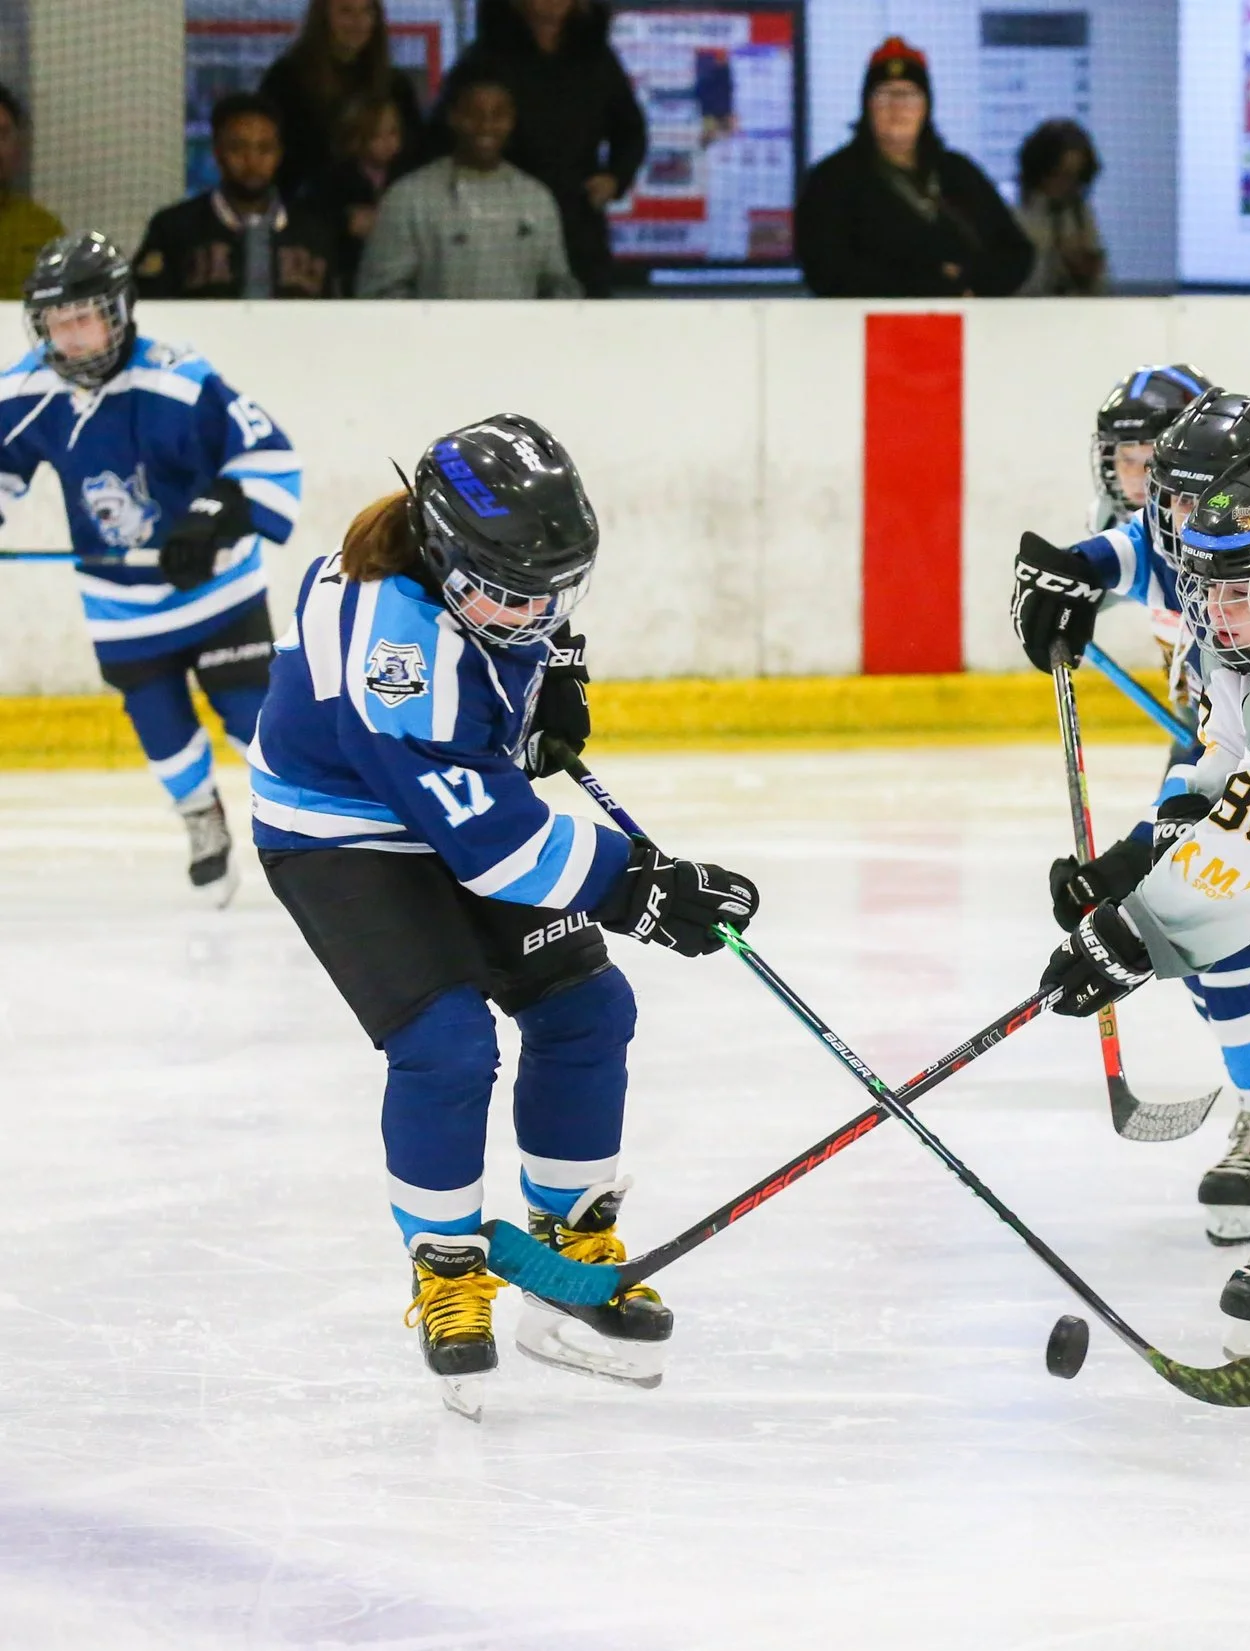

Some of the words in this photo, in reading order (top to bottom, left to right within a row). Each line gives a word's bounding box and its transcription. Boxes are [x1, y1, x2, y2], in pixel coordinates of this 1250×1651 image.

[227, 396, 273, 449] 15
[1170, 468, 1214, 482] BAUER
[1182, 545, 1214, 561] BAUER
[1015, 560, 1104, 603] CCM
[416, 764, 496, 829] 17
[822, 1031, 873, 1080] BAUER
[728, 1113, 879, 1225] FISCHER
[424, 1251, 476, 1265] BAUER
